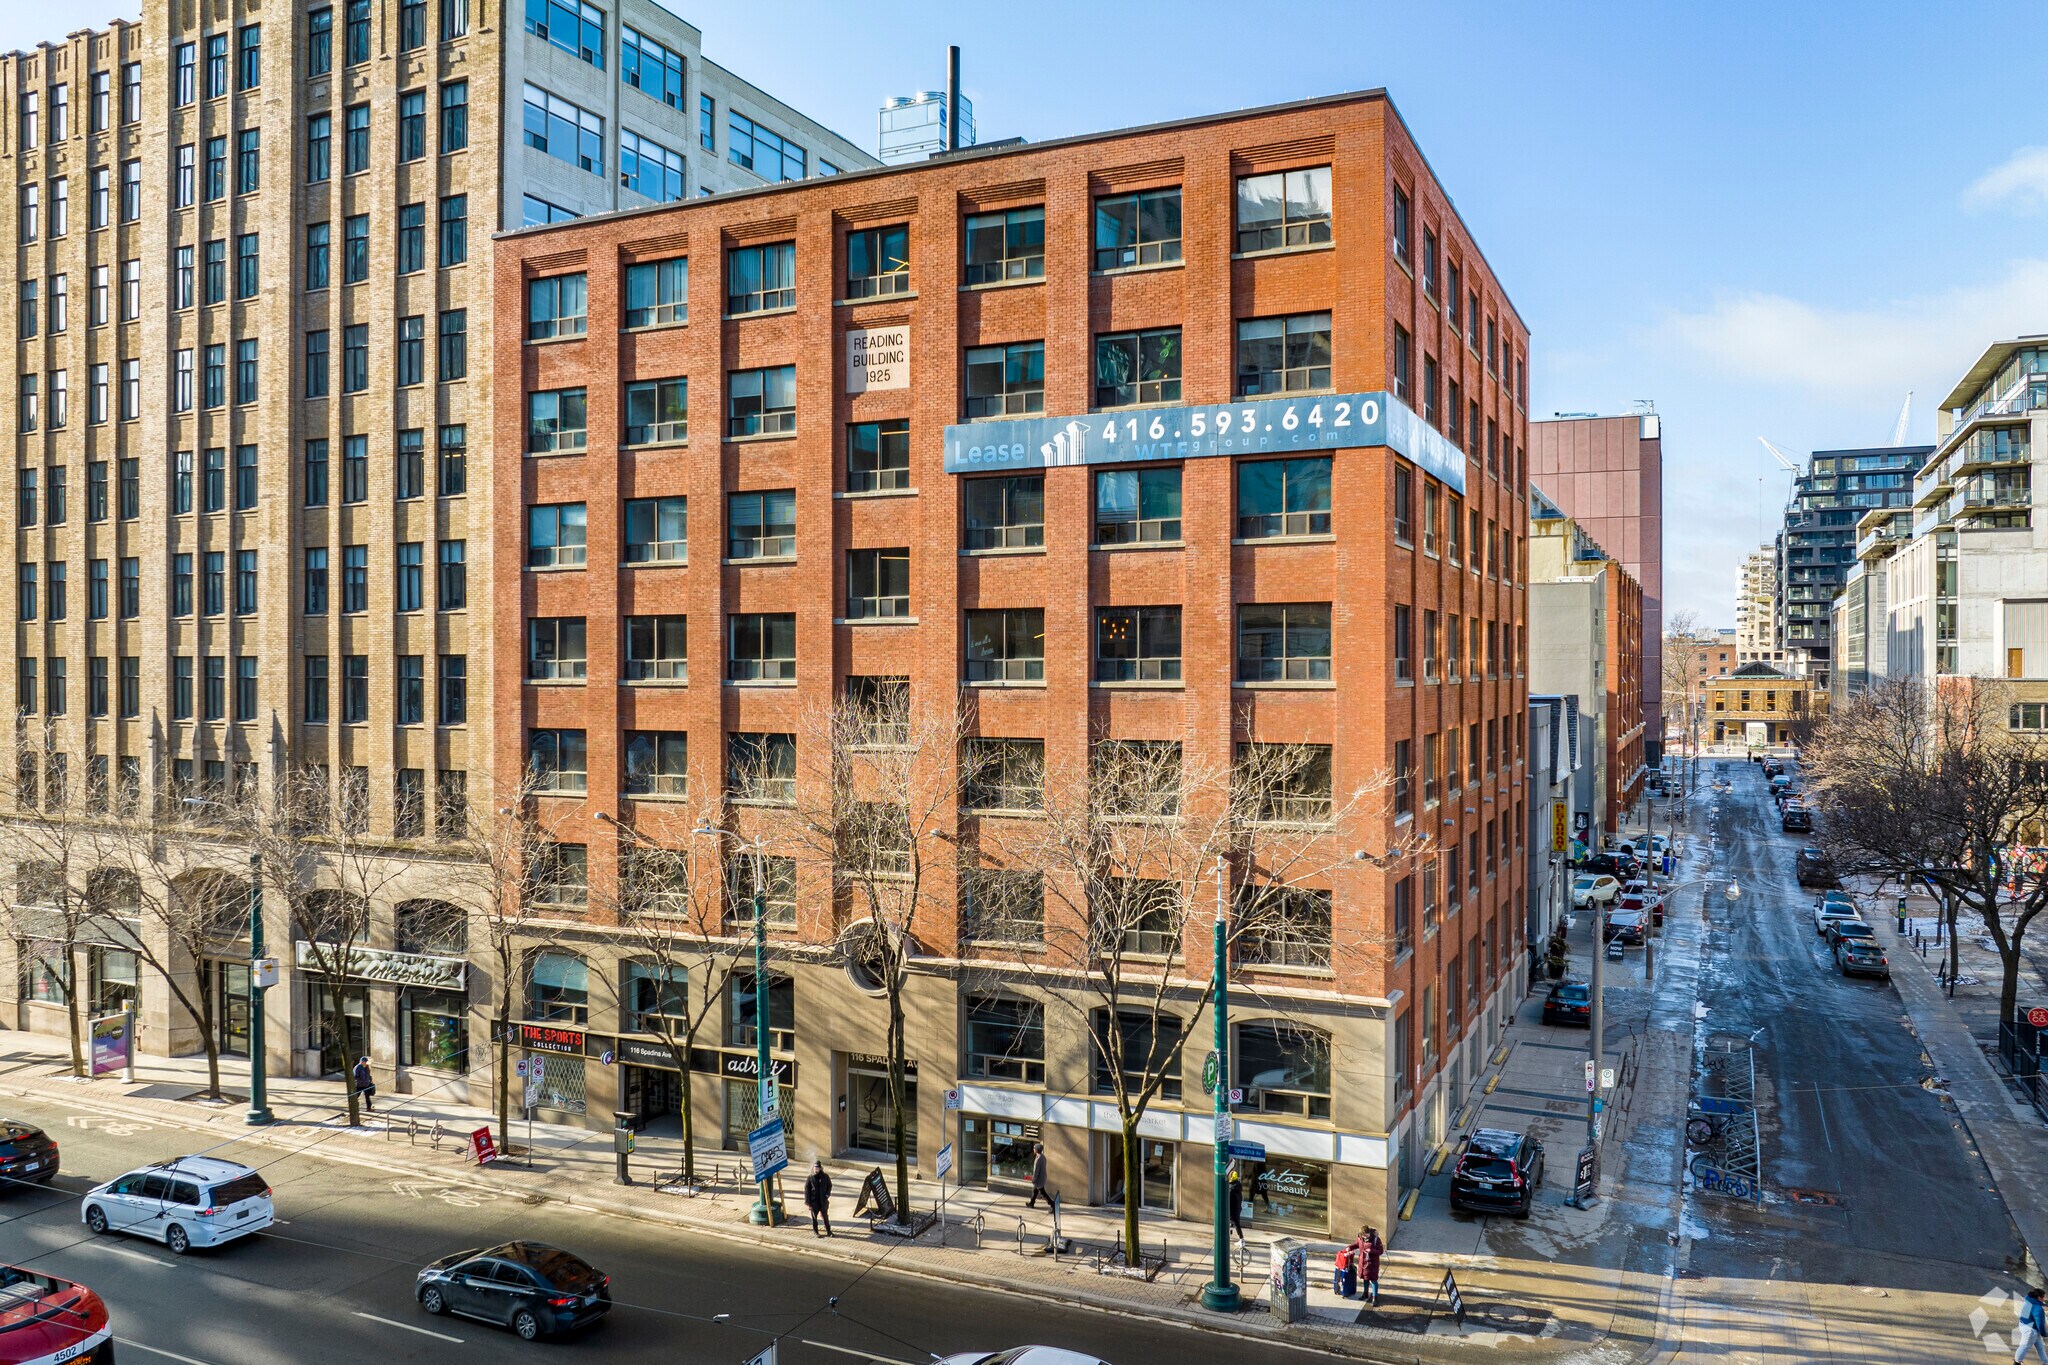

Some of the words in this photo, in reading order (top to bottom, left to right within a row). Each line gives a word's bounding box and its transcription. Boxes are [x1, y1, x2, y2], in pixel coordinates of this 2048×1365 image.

[853, 333, 903, 351] READING
[853, 350, 904, 368] BUILDING
[866, 369, 891, 383] 1925
[1102, 400, 1379, 443] 416.593.6420
[954, 441, 1025, 464] Lease
[1643, 896, 1657, 905] 30
[523, 1025, 542, 1040] THE
[544, 1028, 582, 1046] SPORTS
[533, 1041, 572, 1052] COLLECTION
[630, 1046, 640, 1054] 116
[640, 1048, 661, 1057] Spadina
[850, 1052, 865, 1062] 116
[728, 1056, 787, 1076] adrt
[1233, 1147, 1255, 1155] Spadina
[1258, 1168, 1309, 1186] detox
[54, 1346, 78, 1362] 4502
